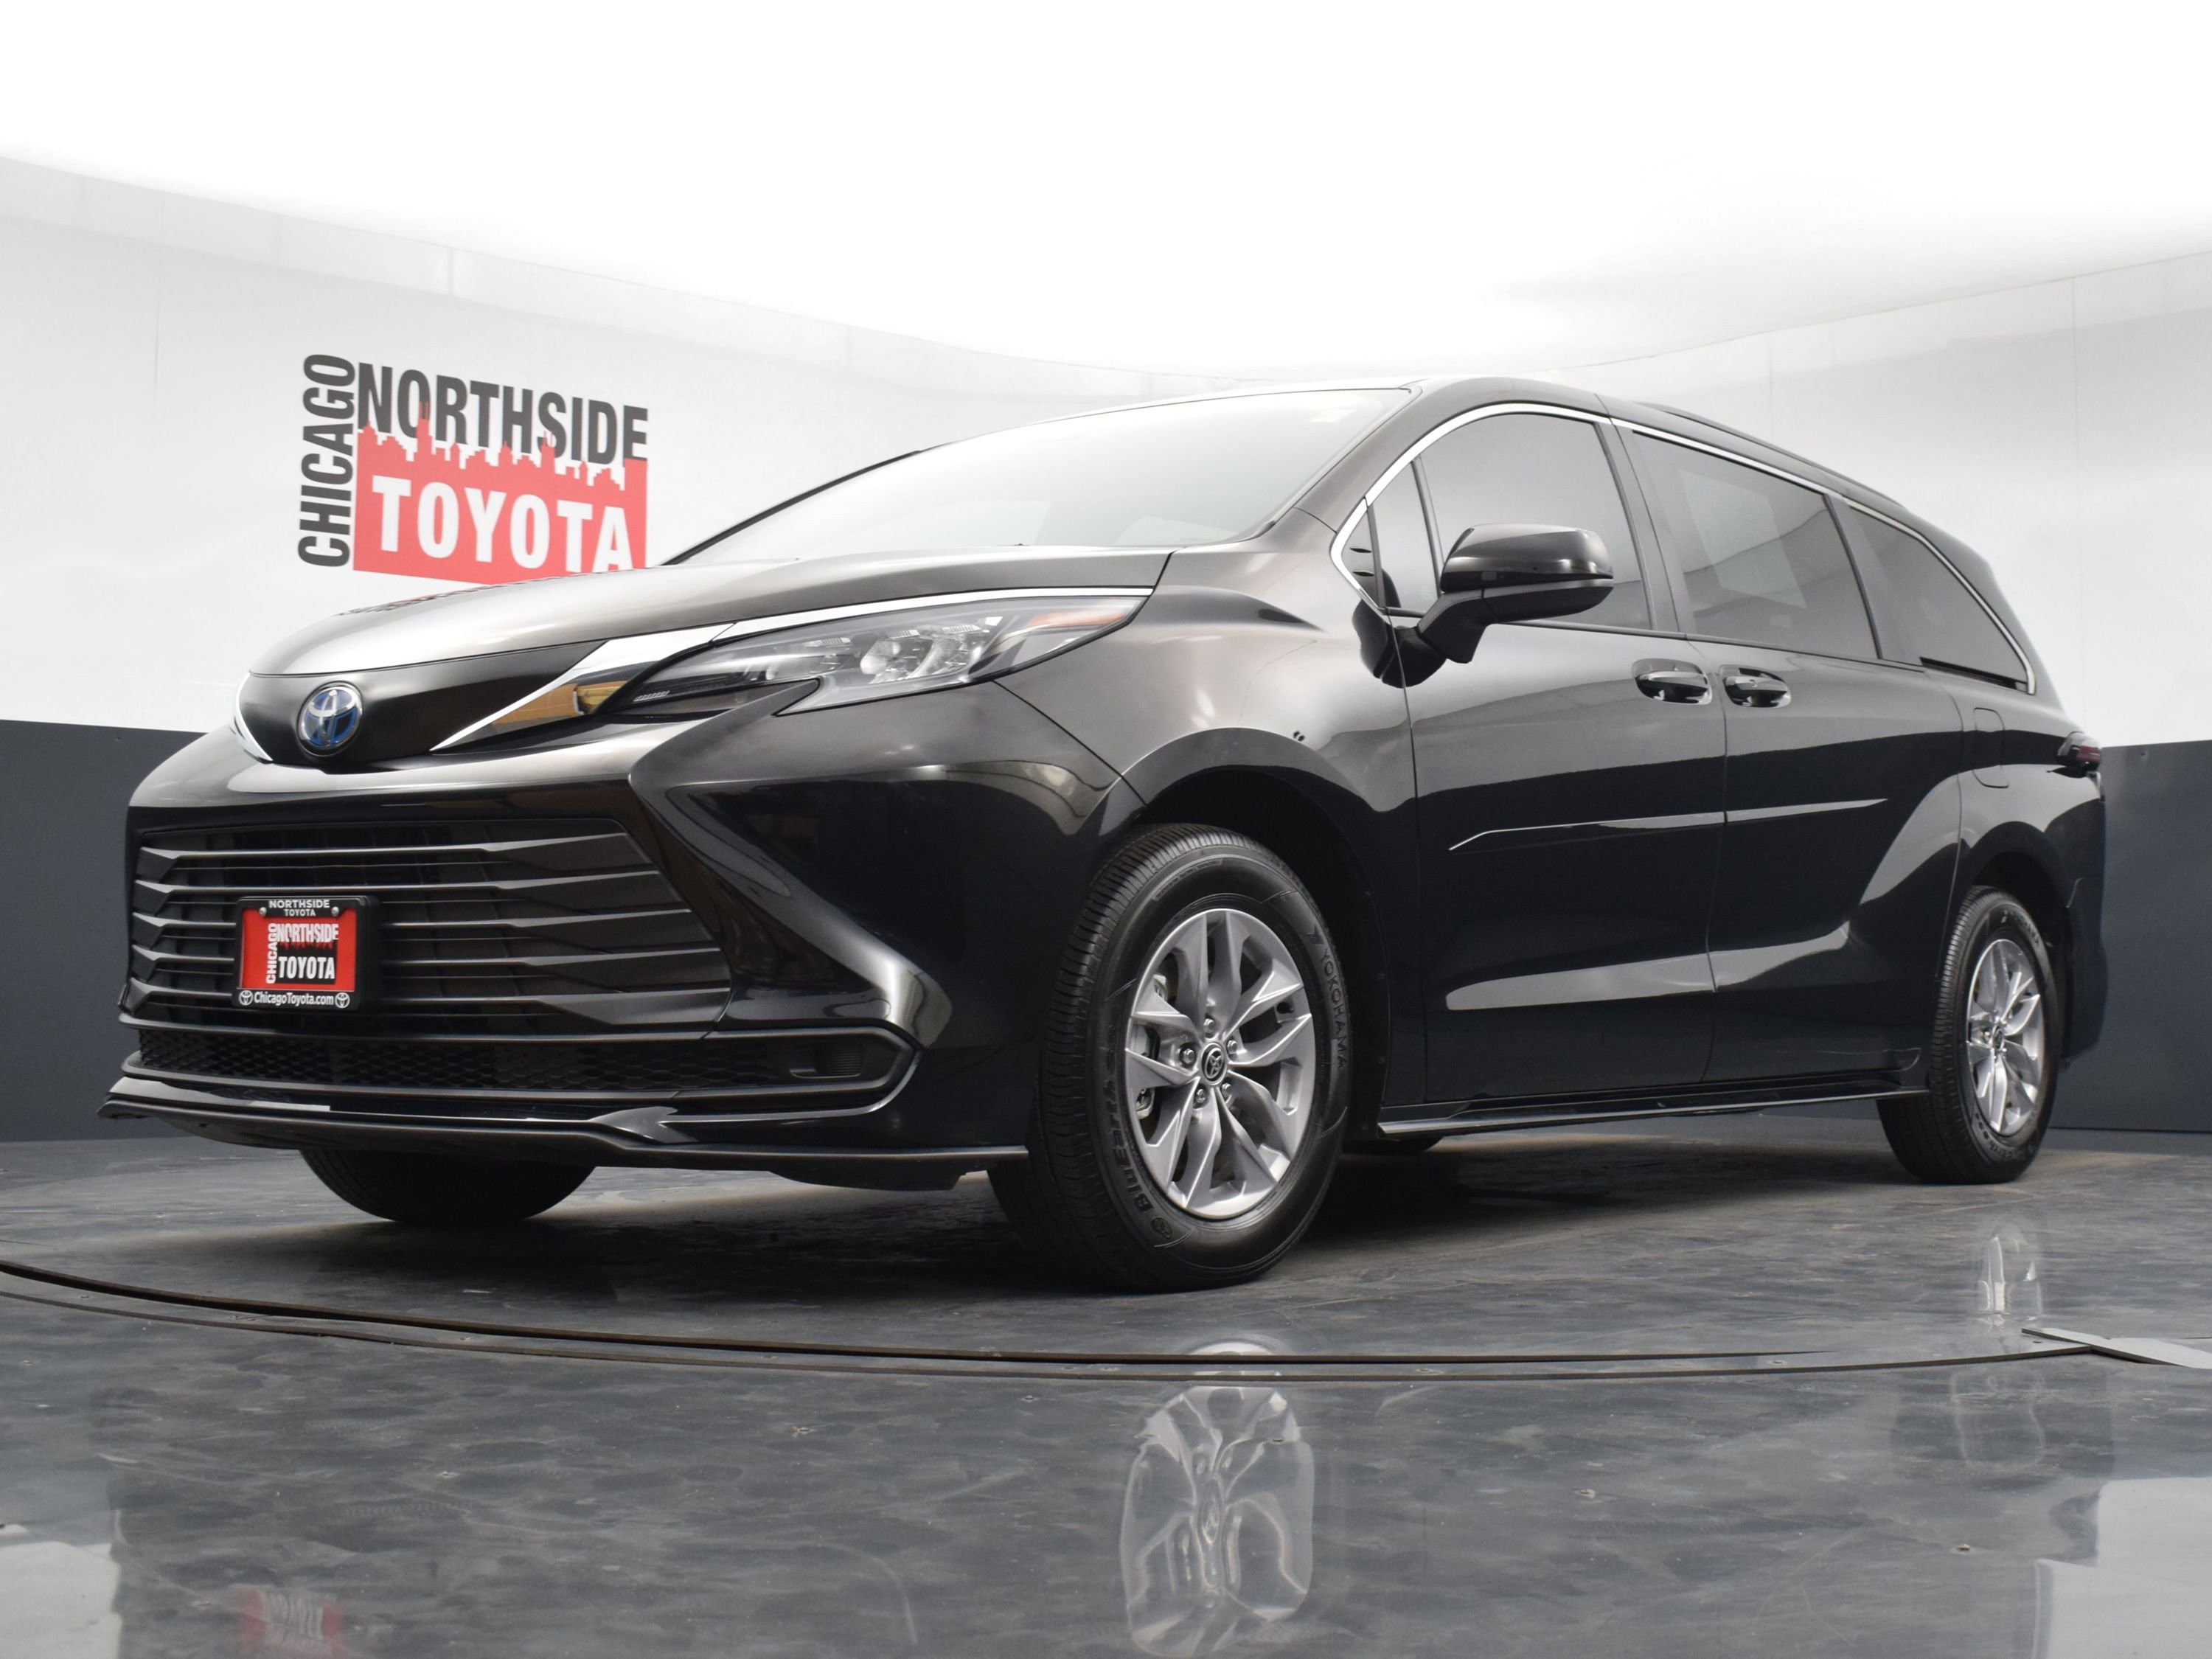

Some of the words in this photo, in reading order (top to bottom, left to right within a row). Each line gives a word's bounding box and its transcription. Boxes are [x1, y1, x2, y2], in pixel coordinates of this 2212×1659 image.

[357, 362, 648, 466] NORTHSIDE
[297, 354, 355, 567] CHICAGO
[372, 475, 633, 574] TOYOTA
[268, 900, 330, 908] NORTHSIDE
[284, 908, 316, 917] TOYOTA
[265, 922, 278, 984] CHICAGO
[276, 923, 339, 942] NORTHSIDE
[278, 956, 335, 979] TOYOTA
[254, 992, 334, 1006] ChicagoToyota.com
[1321, 948, 1347, 1068] YOKOHAMA
